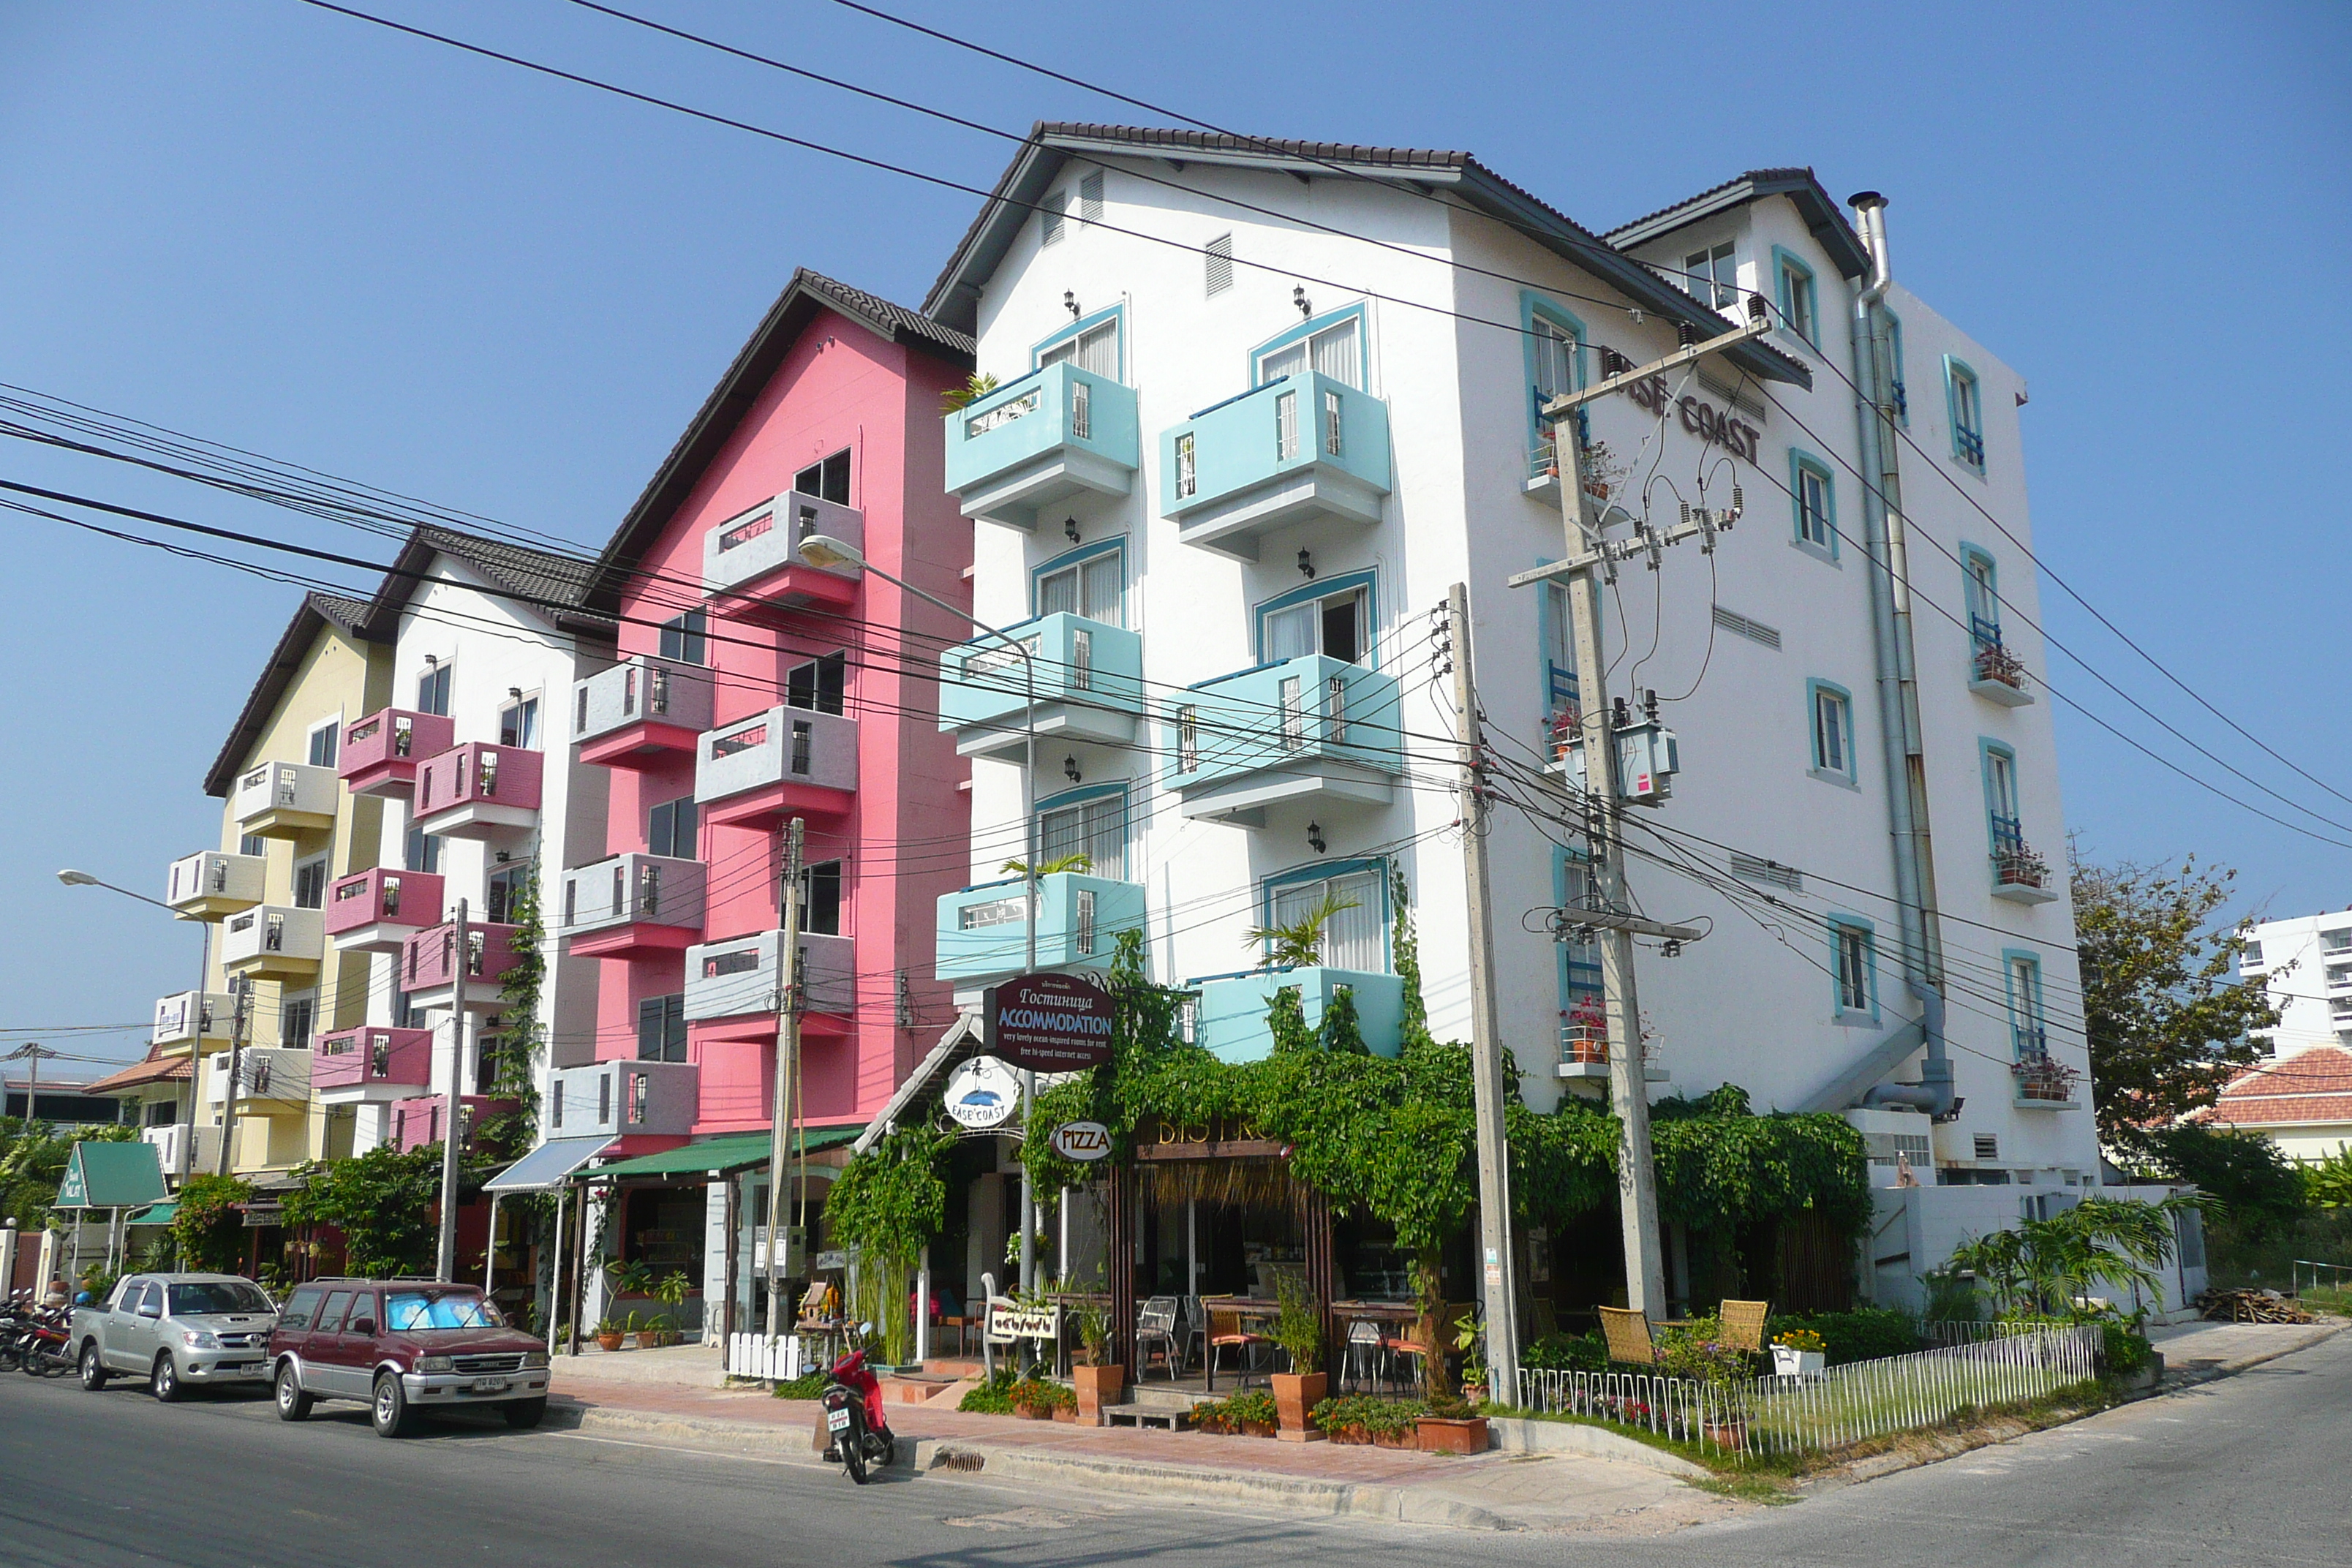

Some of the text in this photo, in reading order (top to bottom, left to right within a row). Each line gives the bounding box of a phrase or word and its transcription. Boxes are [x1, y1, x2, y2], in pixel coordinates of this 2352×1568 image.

[1682, 396, 1760, 465] COAST
[1019, 989, 1093, 1012] Гостиница
[998, 1007, 1112, 1035] ACCOMMODATION
[1003, 1033, 1107, 1048] very lovely ocean-inspired rooms for rent
[1020, 1047, 1030, 1055] free
[1032, 1047, 1053, 1058] hi-speed
[1055, 1049, 1076, 1058] internet
[976, 1105, 1005, 1120] COAST
[1063, 1130, 1110, 1150] PIZZA
